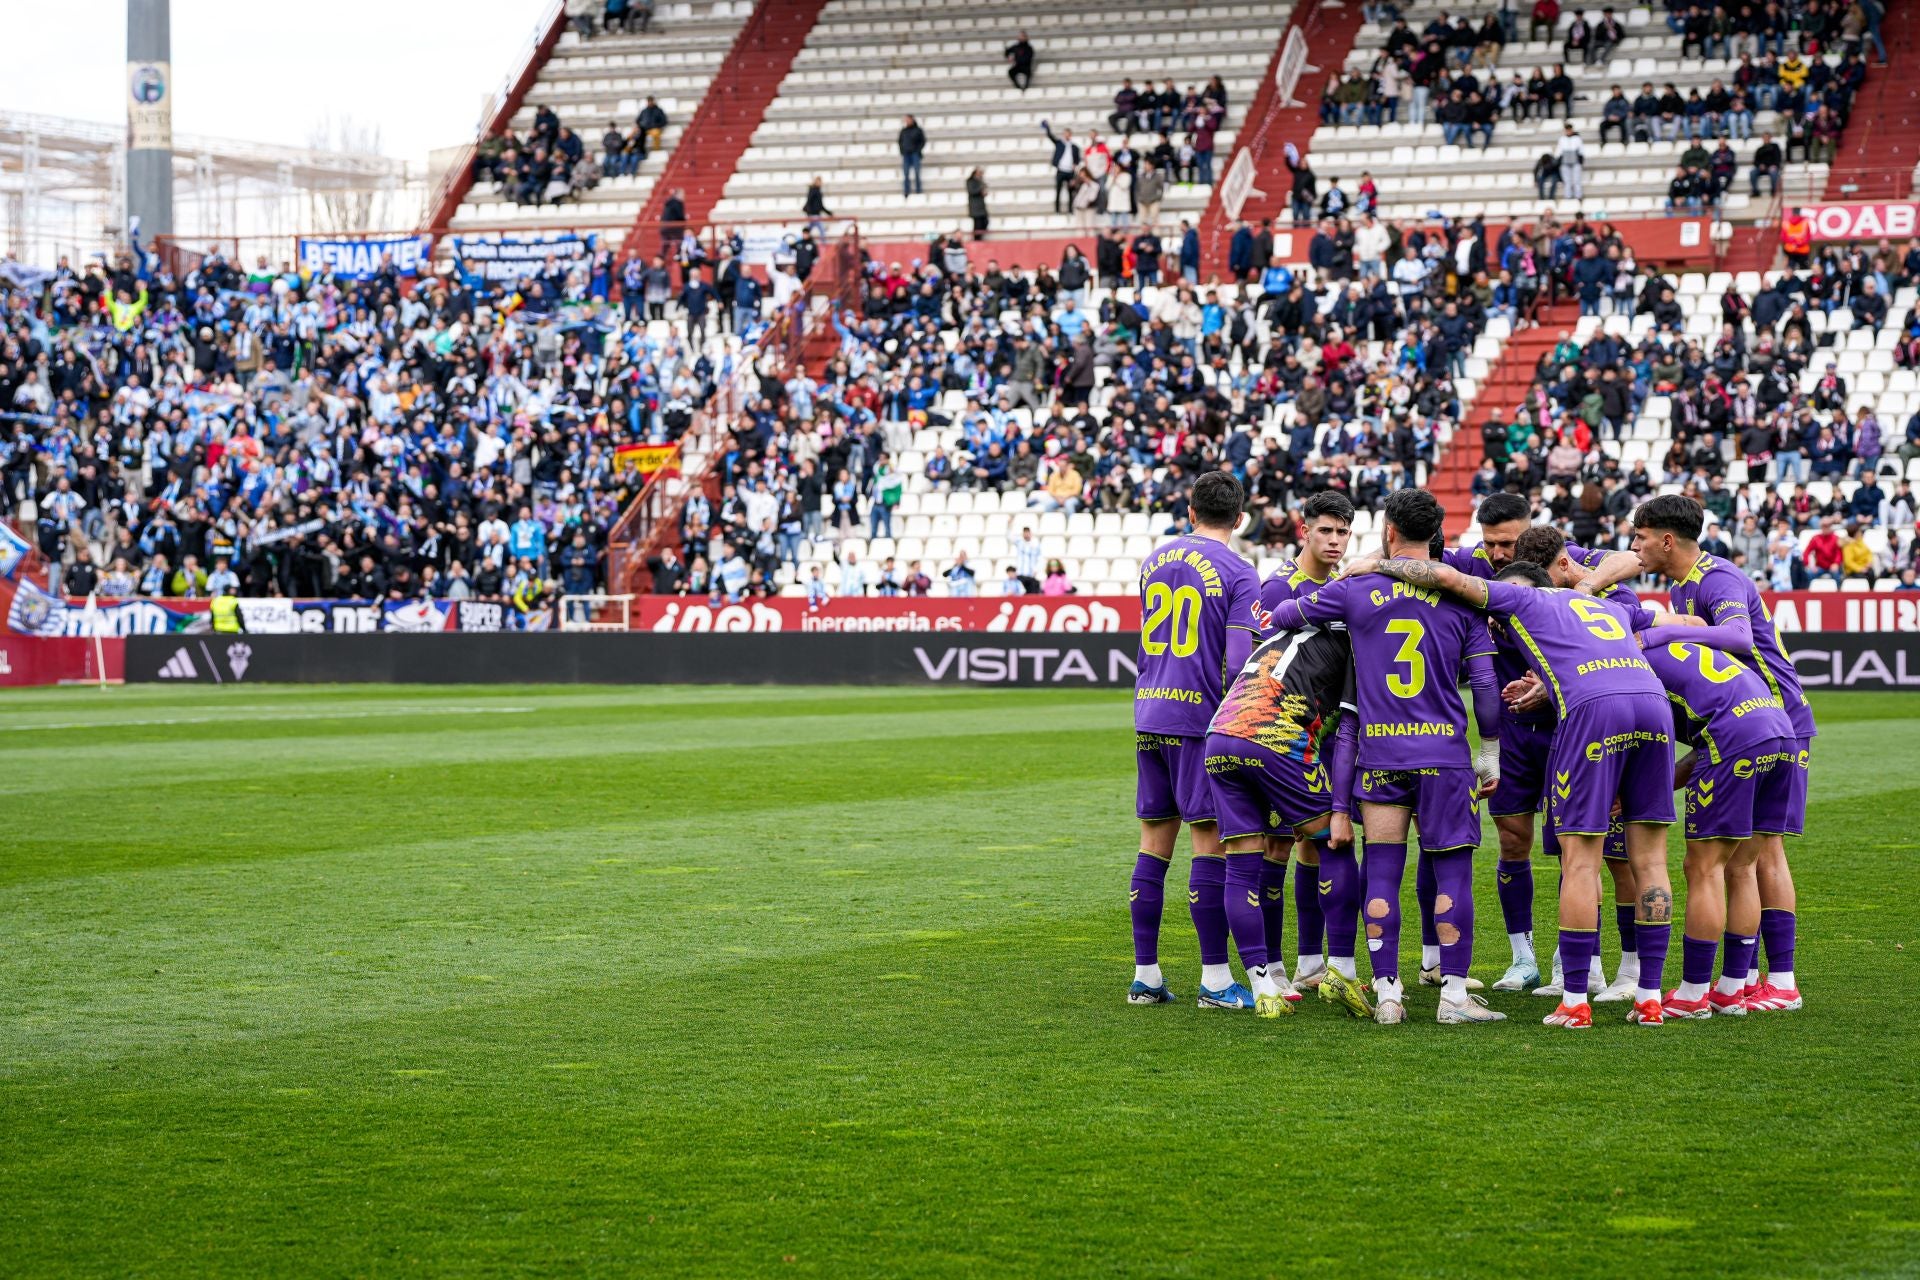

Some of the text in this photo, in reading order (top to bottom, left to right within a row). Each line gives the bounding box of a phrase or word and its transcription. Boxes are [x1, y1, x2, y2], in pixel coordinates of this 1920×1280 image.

[1184, 550, 1223, 597] MONTE
[801, 611, 963, 633] inerenergia.es
[1141, 582, 1202, 657] 20
[1568, 598, 1626, 640] 5
[914, 647, 1098, 682] VISITA
[1384, 619, 1426, 699] 3
[1136, 687, 1203, 705] BENAHAVIS
[1136, 733, 1155, 743] OSTA
[1165, 736, 1182, 746] SOL
[1365, 722, 1455, 738] BENAHAVIS
[1603, 730, 1669, 747] COSTA DEL SO
[1244, 758, 1264, 768] SOL
